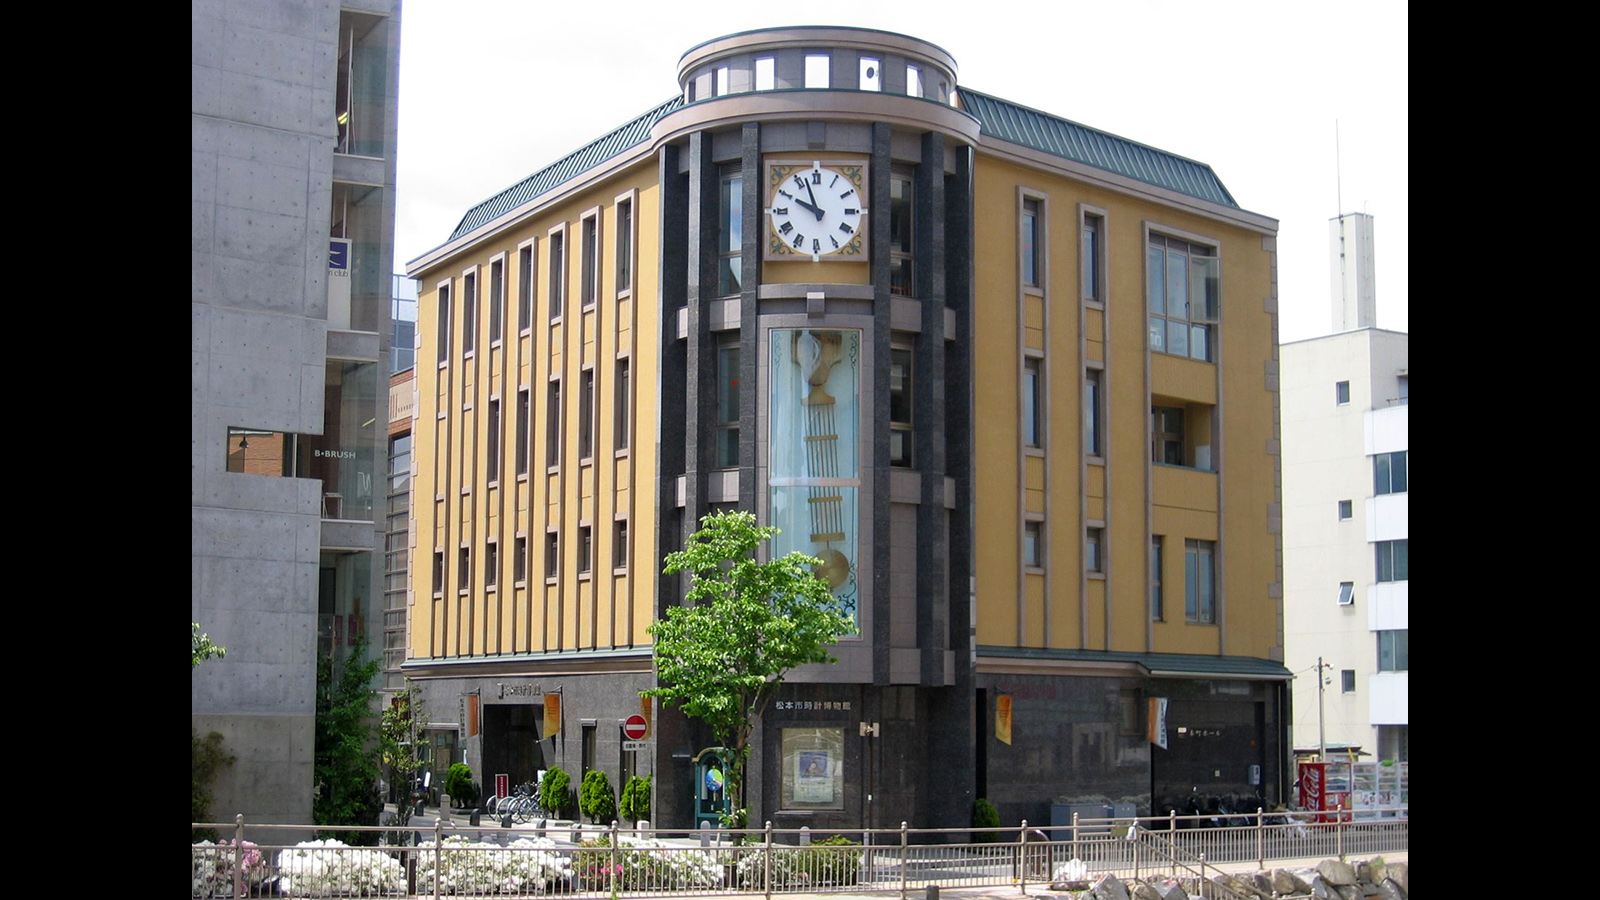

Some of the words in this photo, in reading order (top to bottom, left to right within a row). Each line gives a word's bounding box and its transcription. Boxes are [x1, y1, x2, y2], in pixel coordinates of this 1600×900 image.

[775, 701, 851, 710] 松本市時計博物館
[1303, 764, 1320, 823] ca-Cola
